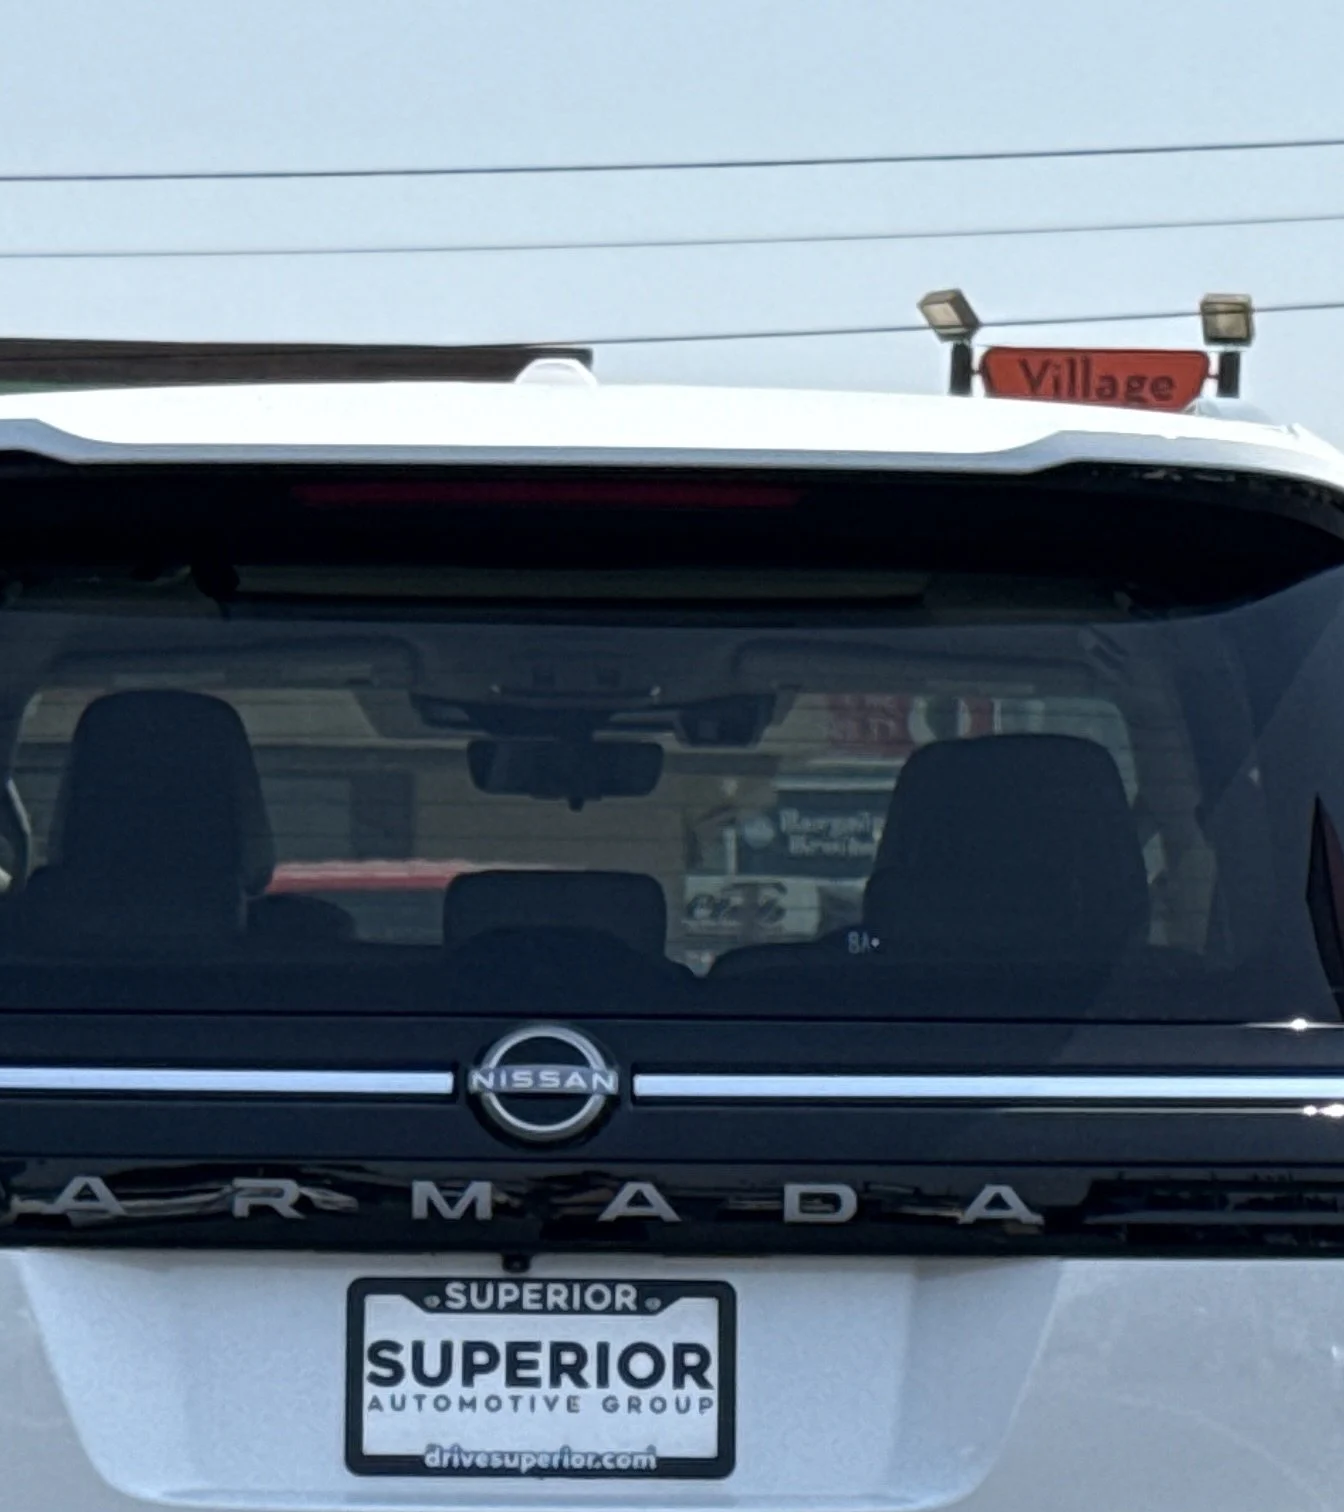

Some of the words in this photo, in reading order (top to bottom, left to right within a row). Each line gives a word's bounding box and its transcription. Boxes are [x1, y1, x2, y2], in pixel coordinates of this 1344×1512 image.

[1018, 355, 1177, 403] Village
[471, 1070, 615, 1090] NISSAN
[50, 1174, 1045, 1227] ARMADA
[444, 1282, 639, 1312] SUPERIOR
[366, 1340, 714, 1390] SUPERIOR
[367, 1394, 581, 1414] AUTOMOTIVE
[602, 1396, 715, 1415] GROUP
[424, 1443, 658, 1474] drivesuperior.com
